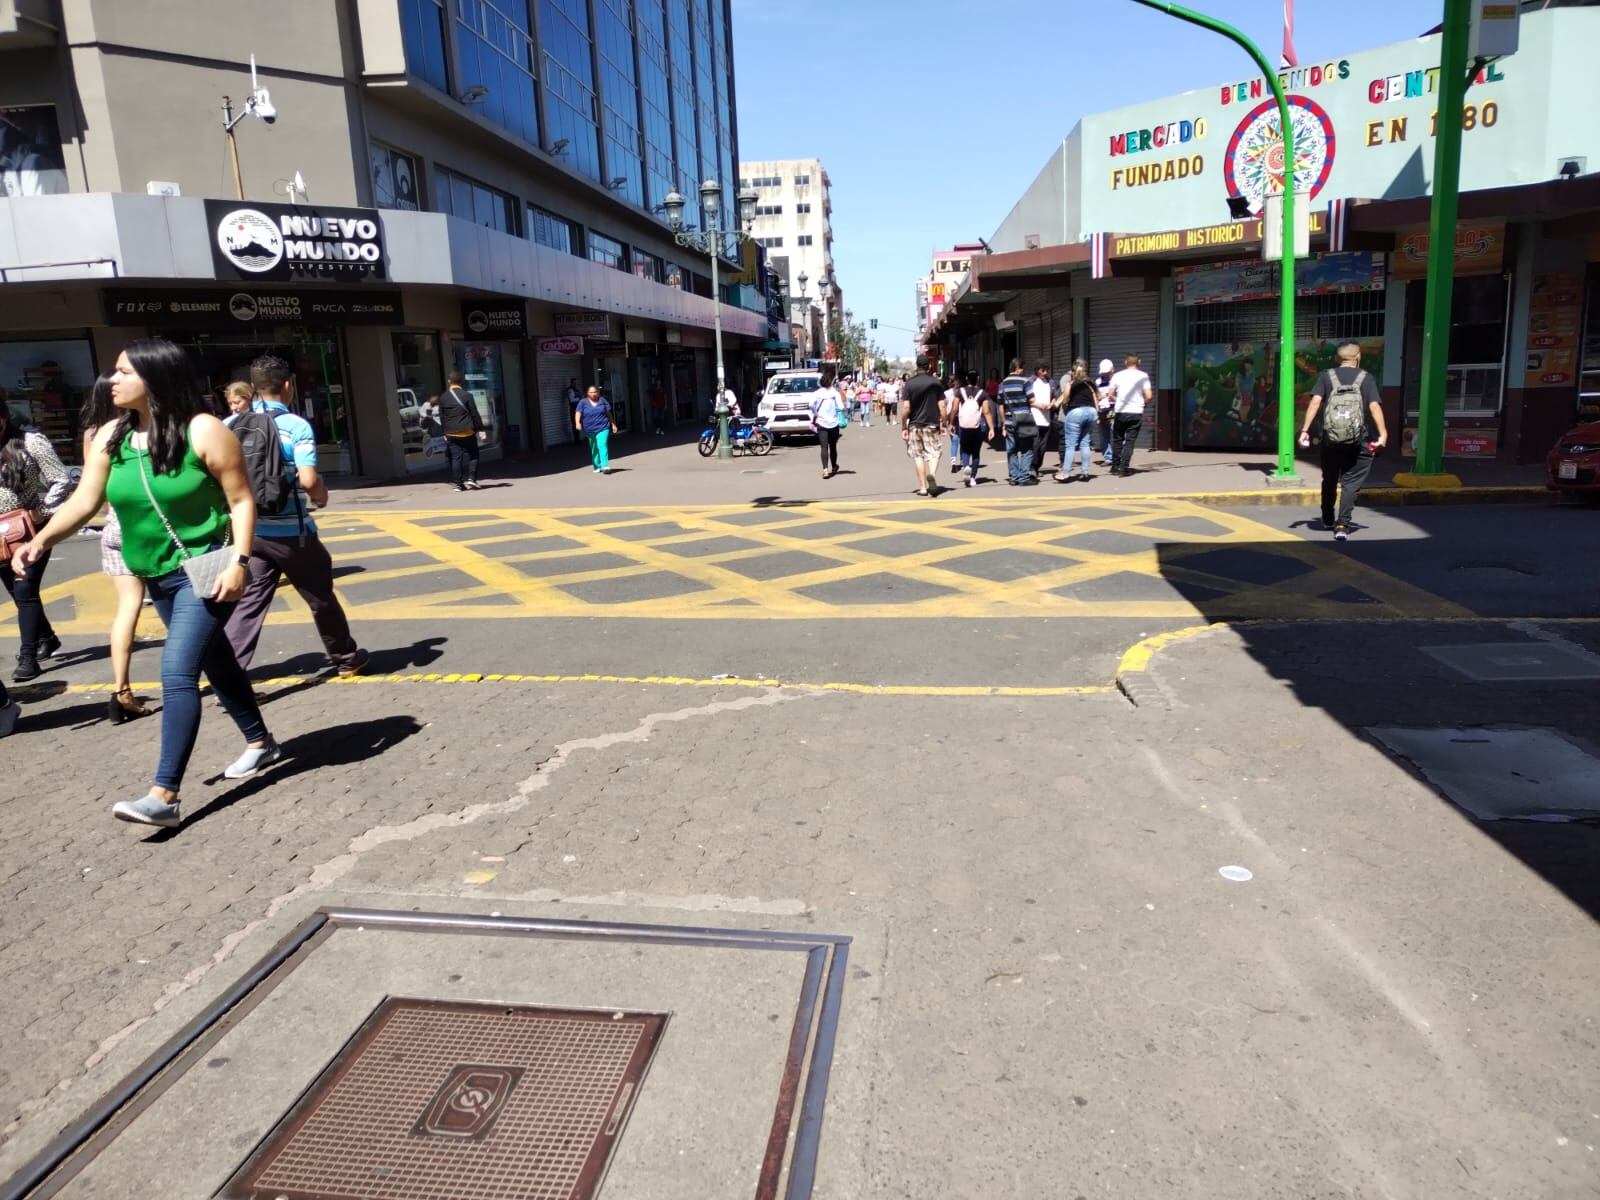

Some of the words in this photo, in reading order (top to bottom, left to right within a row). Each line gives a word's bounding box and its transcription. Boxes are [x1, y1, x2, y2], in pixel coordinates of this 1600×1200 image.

[1368, 62, 1505, 104] CENTAL
[1366, 115, 1408, 147] EN
[1109, 117, 1208, 157] MERCADO
[1111, 153, 1204, 190] FUNDADO
[280, 214, 377, 240] NUEVO
[1116, 233, 1179, 255] PATRIMONIO
[1187, 223, 1244, 247] HISTORICO
[284, 240, 380, 262] MUNDO
[288, 263, 376, 272] LIFESTYLE
[937, 261, 953, 272] LA
[257, 296, 300, 306] NUEVO
[116, 302, 145, 312] FOX
[181, 303, 222, 312] ELEMENT
[258, 306, 301, 316] MUNDO
[488, 311, 521, 319] NUEVO
[489, 318, 521, 327] MUNDO
